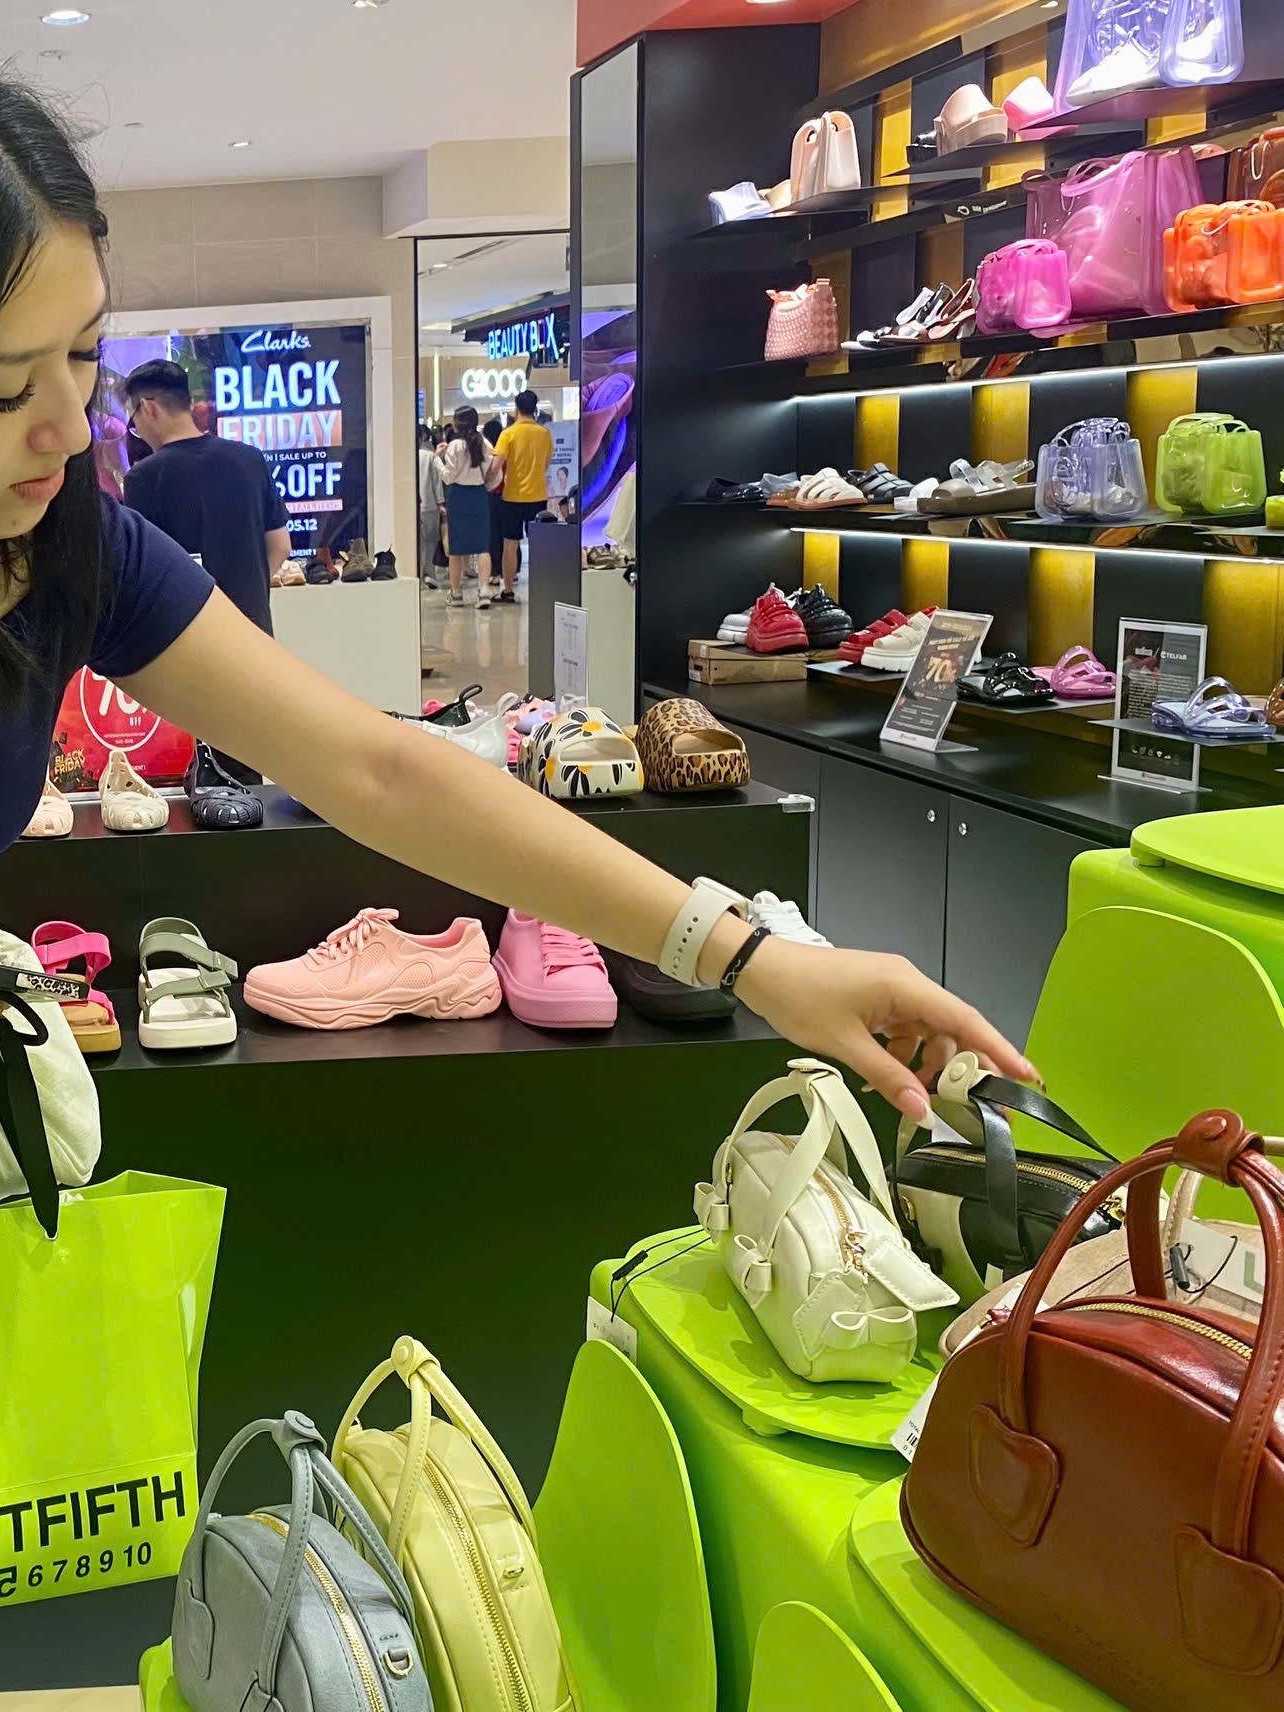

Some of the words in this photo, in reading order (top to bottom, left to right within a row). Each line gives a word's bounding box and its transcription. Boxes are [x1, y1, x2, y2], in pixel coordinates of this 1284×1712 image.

[487, 323, 529, 361] BEAUTY
[214, 359, 342, 412] BLACK
[221, 410, 337, 450] FRIDAY
[279, 452, 300, 461] SALE
[301, 452, 313, 460] UP
[315, 451, 327, 459] TO
[286, 518, 318, 532] 05.12
[55, 748, 84, 764] BLACK
[54, 758, 86, 776] FRIDAY
